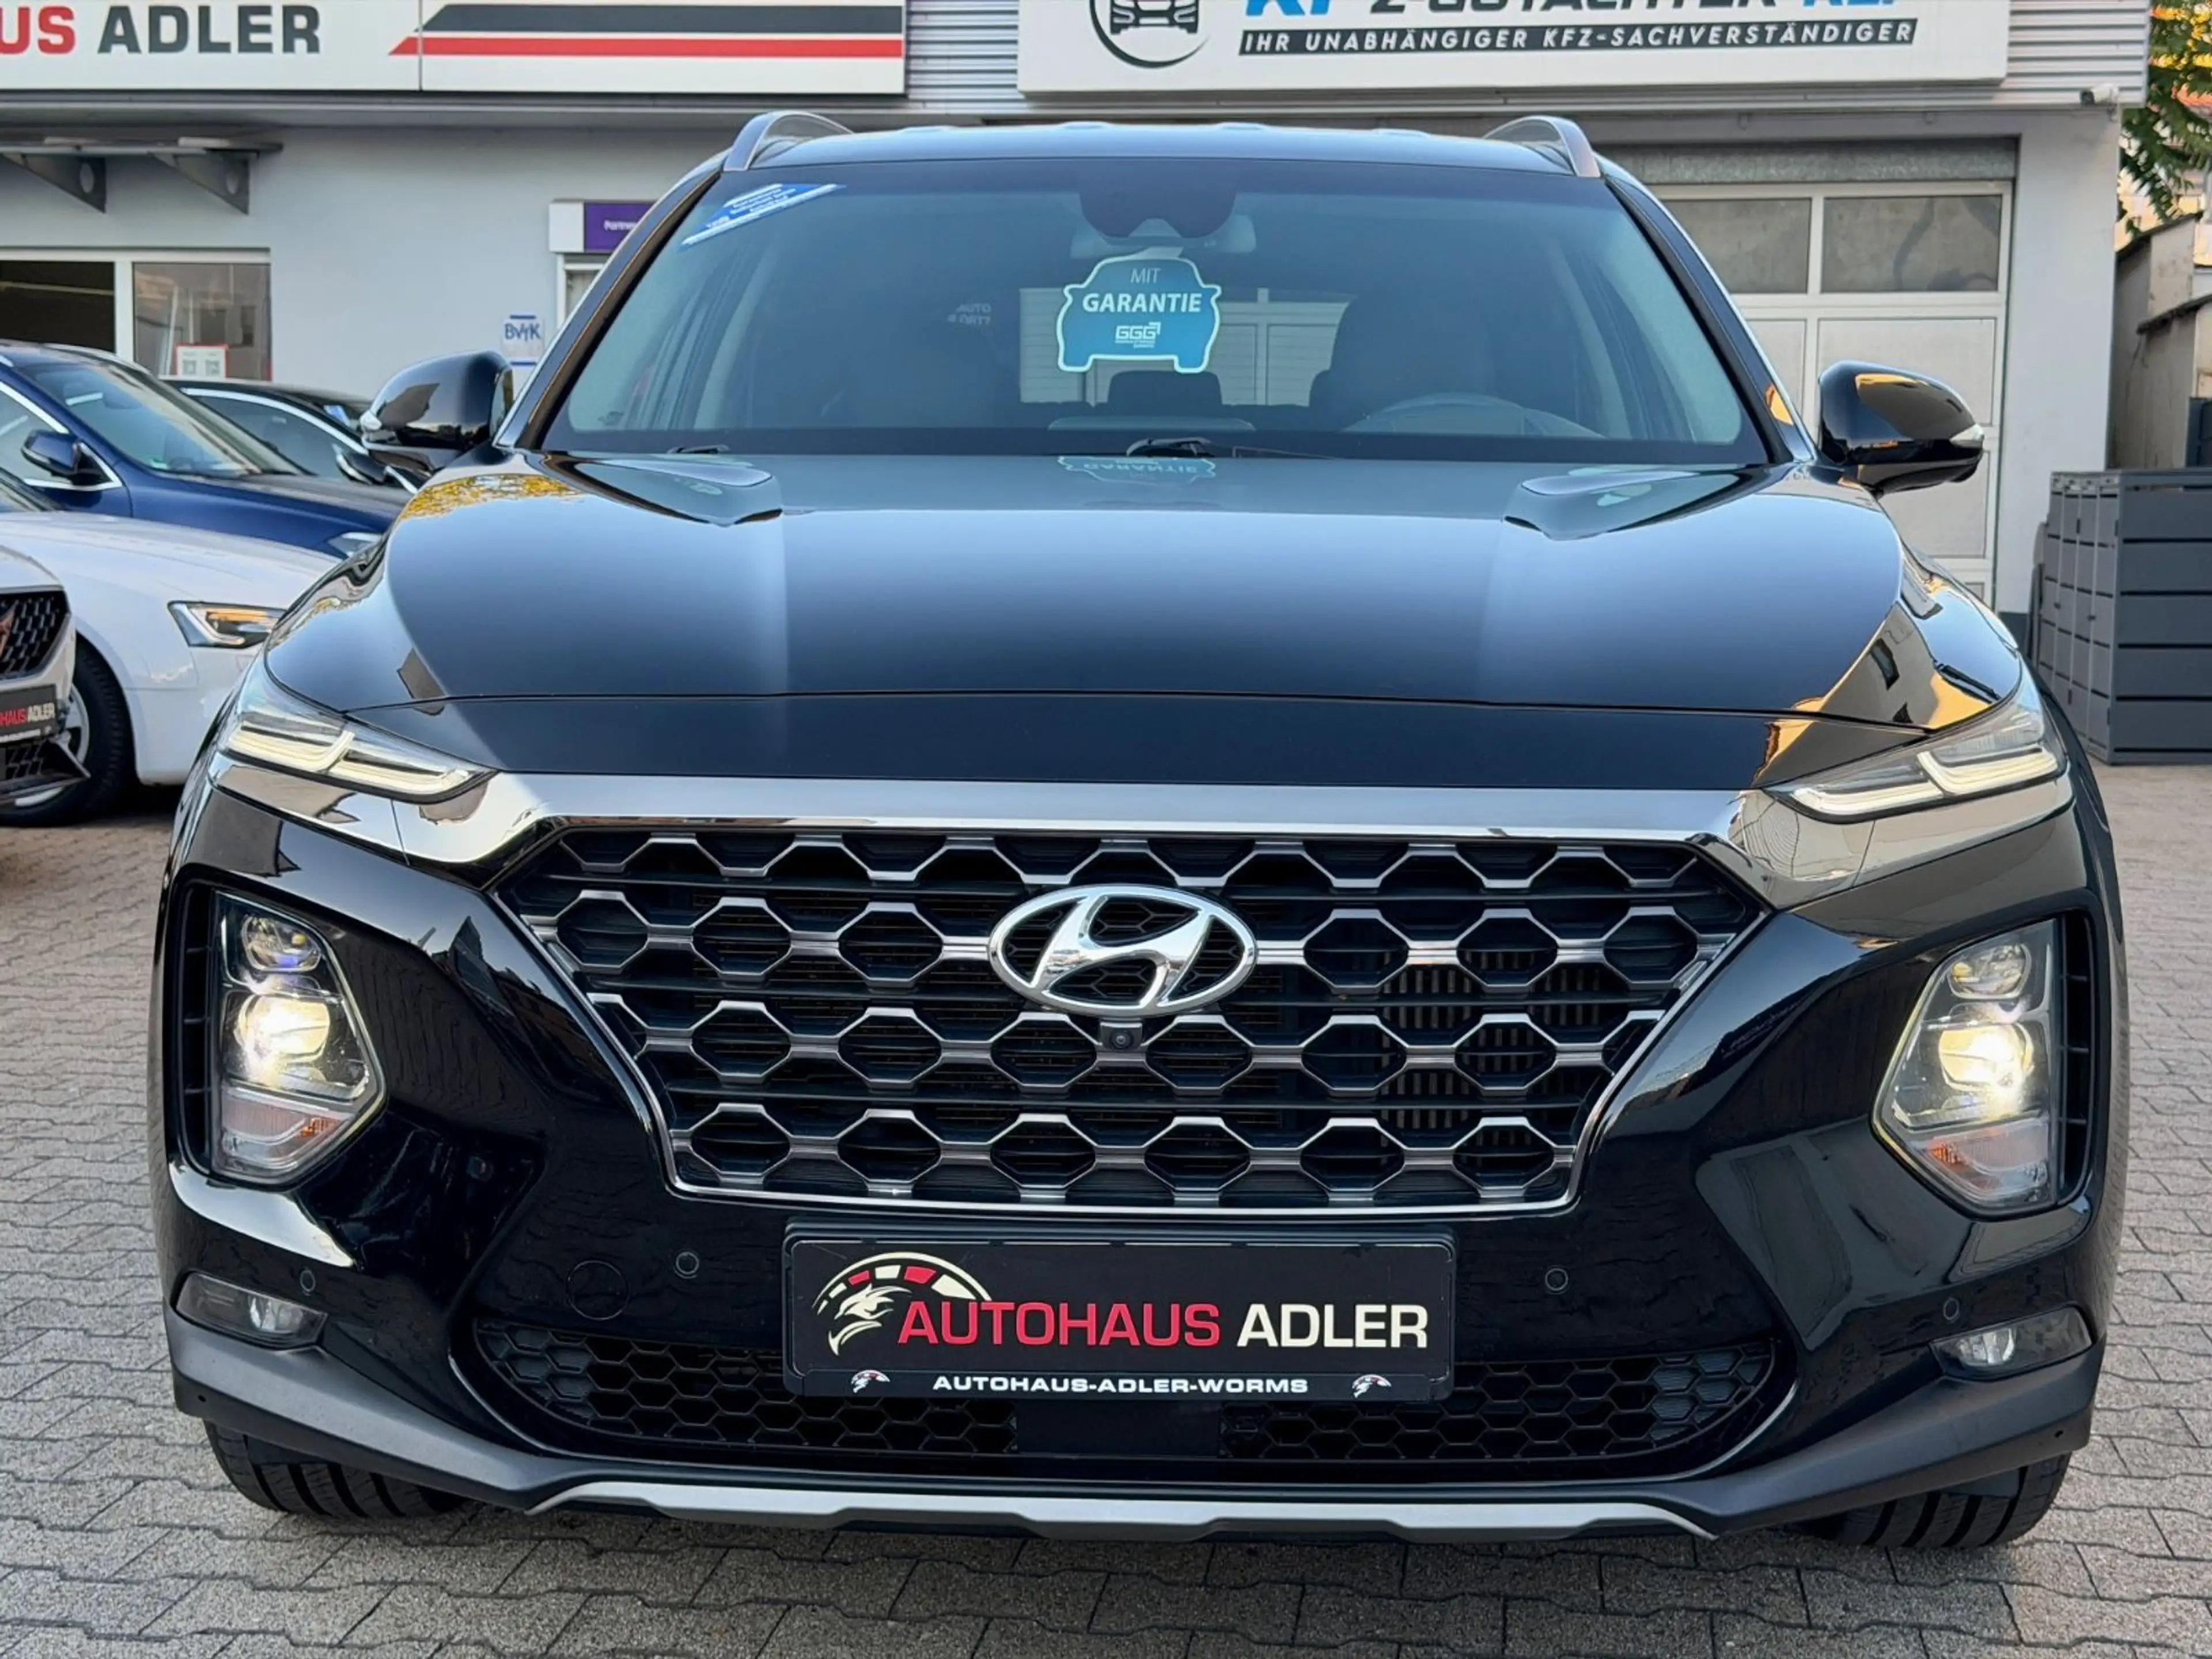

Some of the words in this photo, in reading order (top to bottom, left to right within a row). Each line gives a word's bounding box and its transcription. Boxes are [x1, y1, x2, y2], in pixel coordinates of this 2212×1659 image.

[97, 5, 321, 54] ADLER
[1244, 33, 1290, 51] IHR
[1305, 27, 1528, 51] UNABHÄNGIGER
[1543, 21, 1912, 48] KFZ-SACHVERSTÄNDIGER
[1130, 268, 1161, 283] MIT
[1082, 293, 1202, 313] GARANTIE
[27, 702, 55, 723] ADLER
[897, 1301, 1221, 1347] AUTOHAUS
[1236, 1303, 1429, 1349] ADLER
[933, 1375, 1308, 1394] AUTOHAUS-ADLER-WORMS
